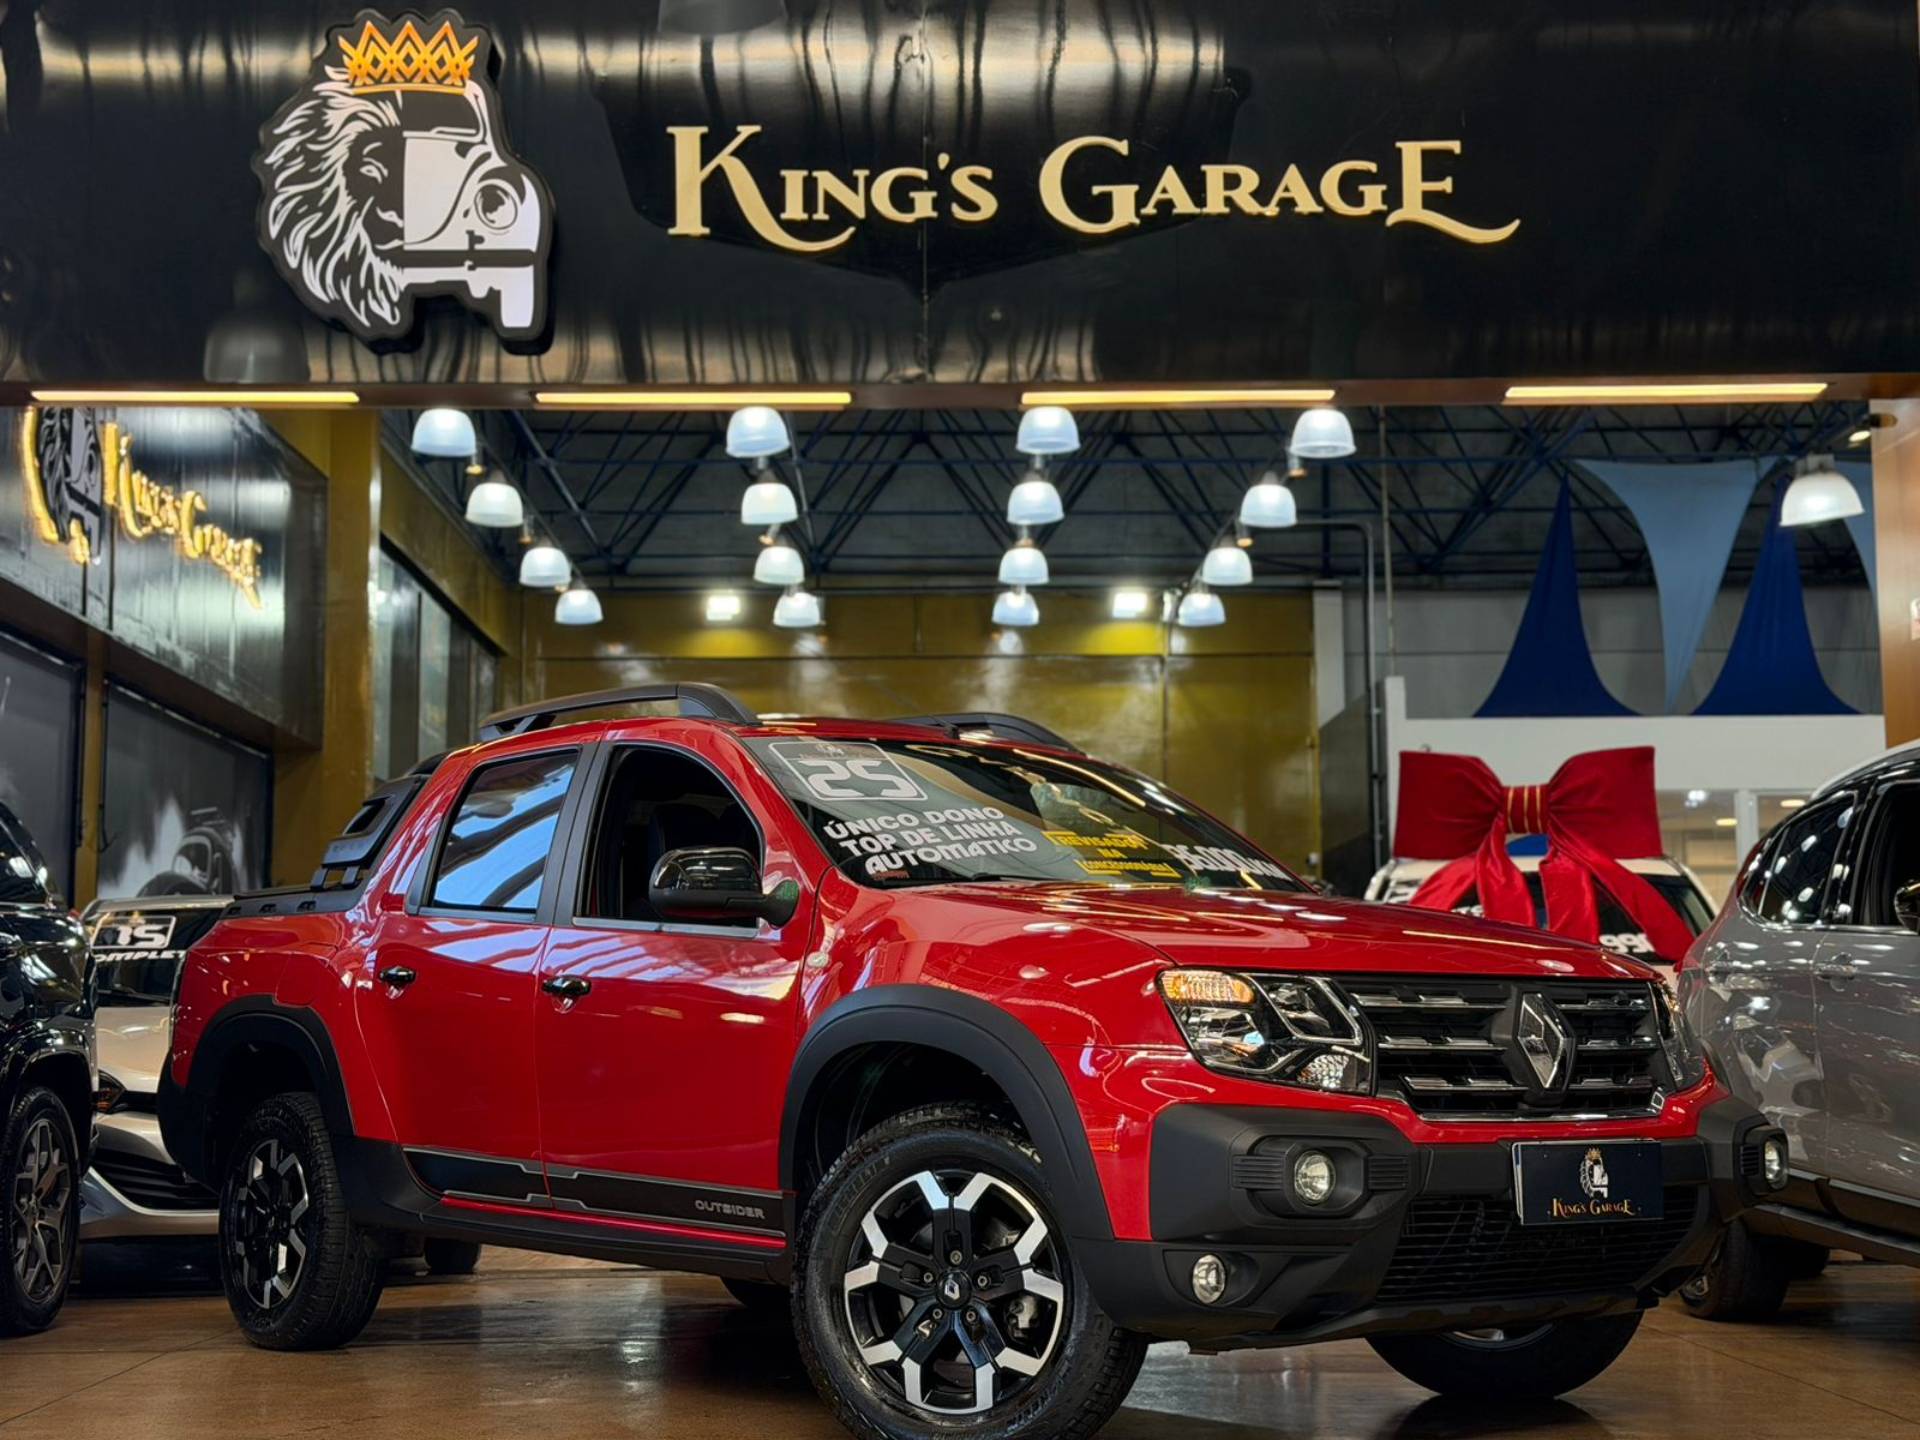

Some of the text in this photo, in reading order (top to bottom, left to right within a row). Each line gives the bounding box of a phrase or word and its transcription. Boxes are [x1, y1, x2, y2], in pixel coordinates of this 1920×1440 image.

[667, 125, 1521, 252] KING'S GARAGE
[799, 760, 918, 798] 25
[823, 807, 1005, 840] ÚNICO DONO
[839, 820, 1022, 857] TOP DE LINHA
[695, 1200, 765, 1219] OUTSIDER
[1590, 1199, 1636, 1217] GARAGE
